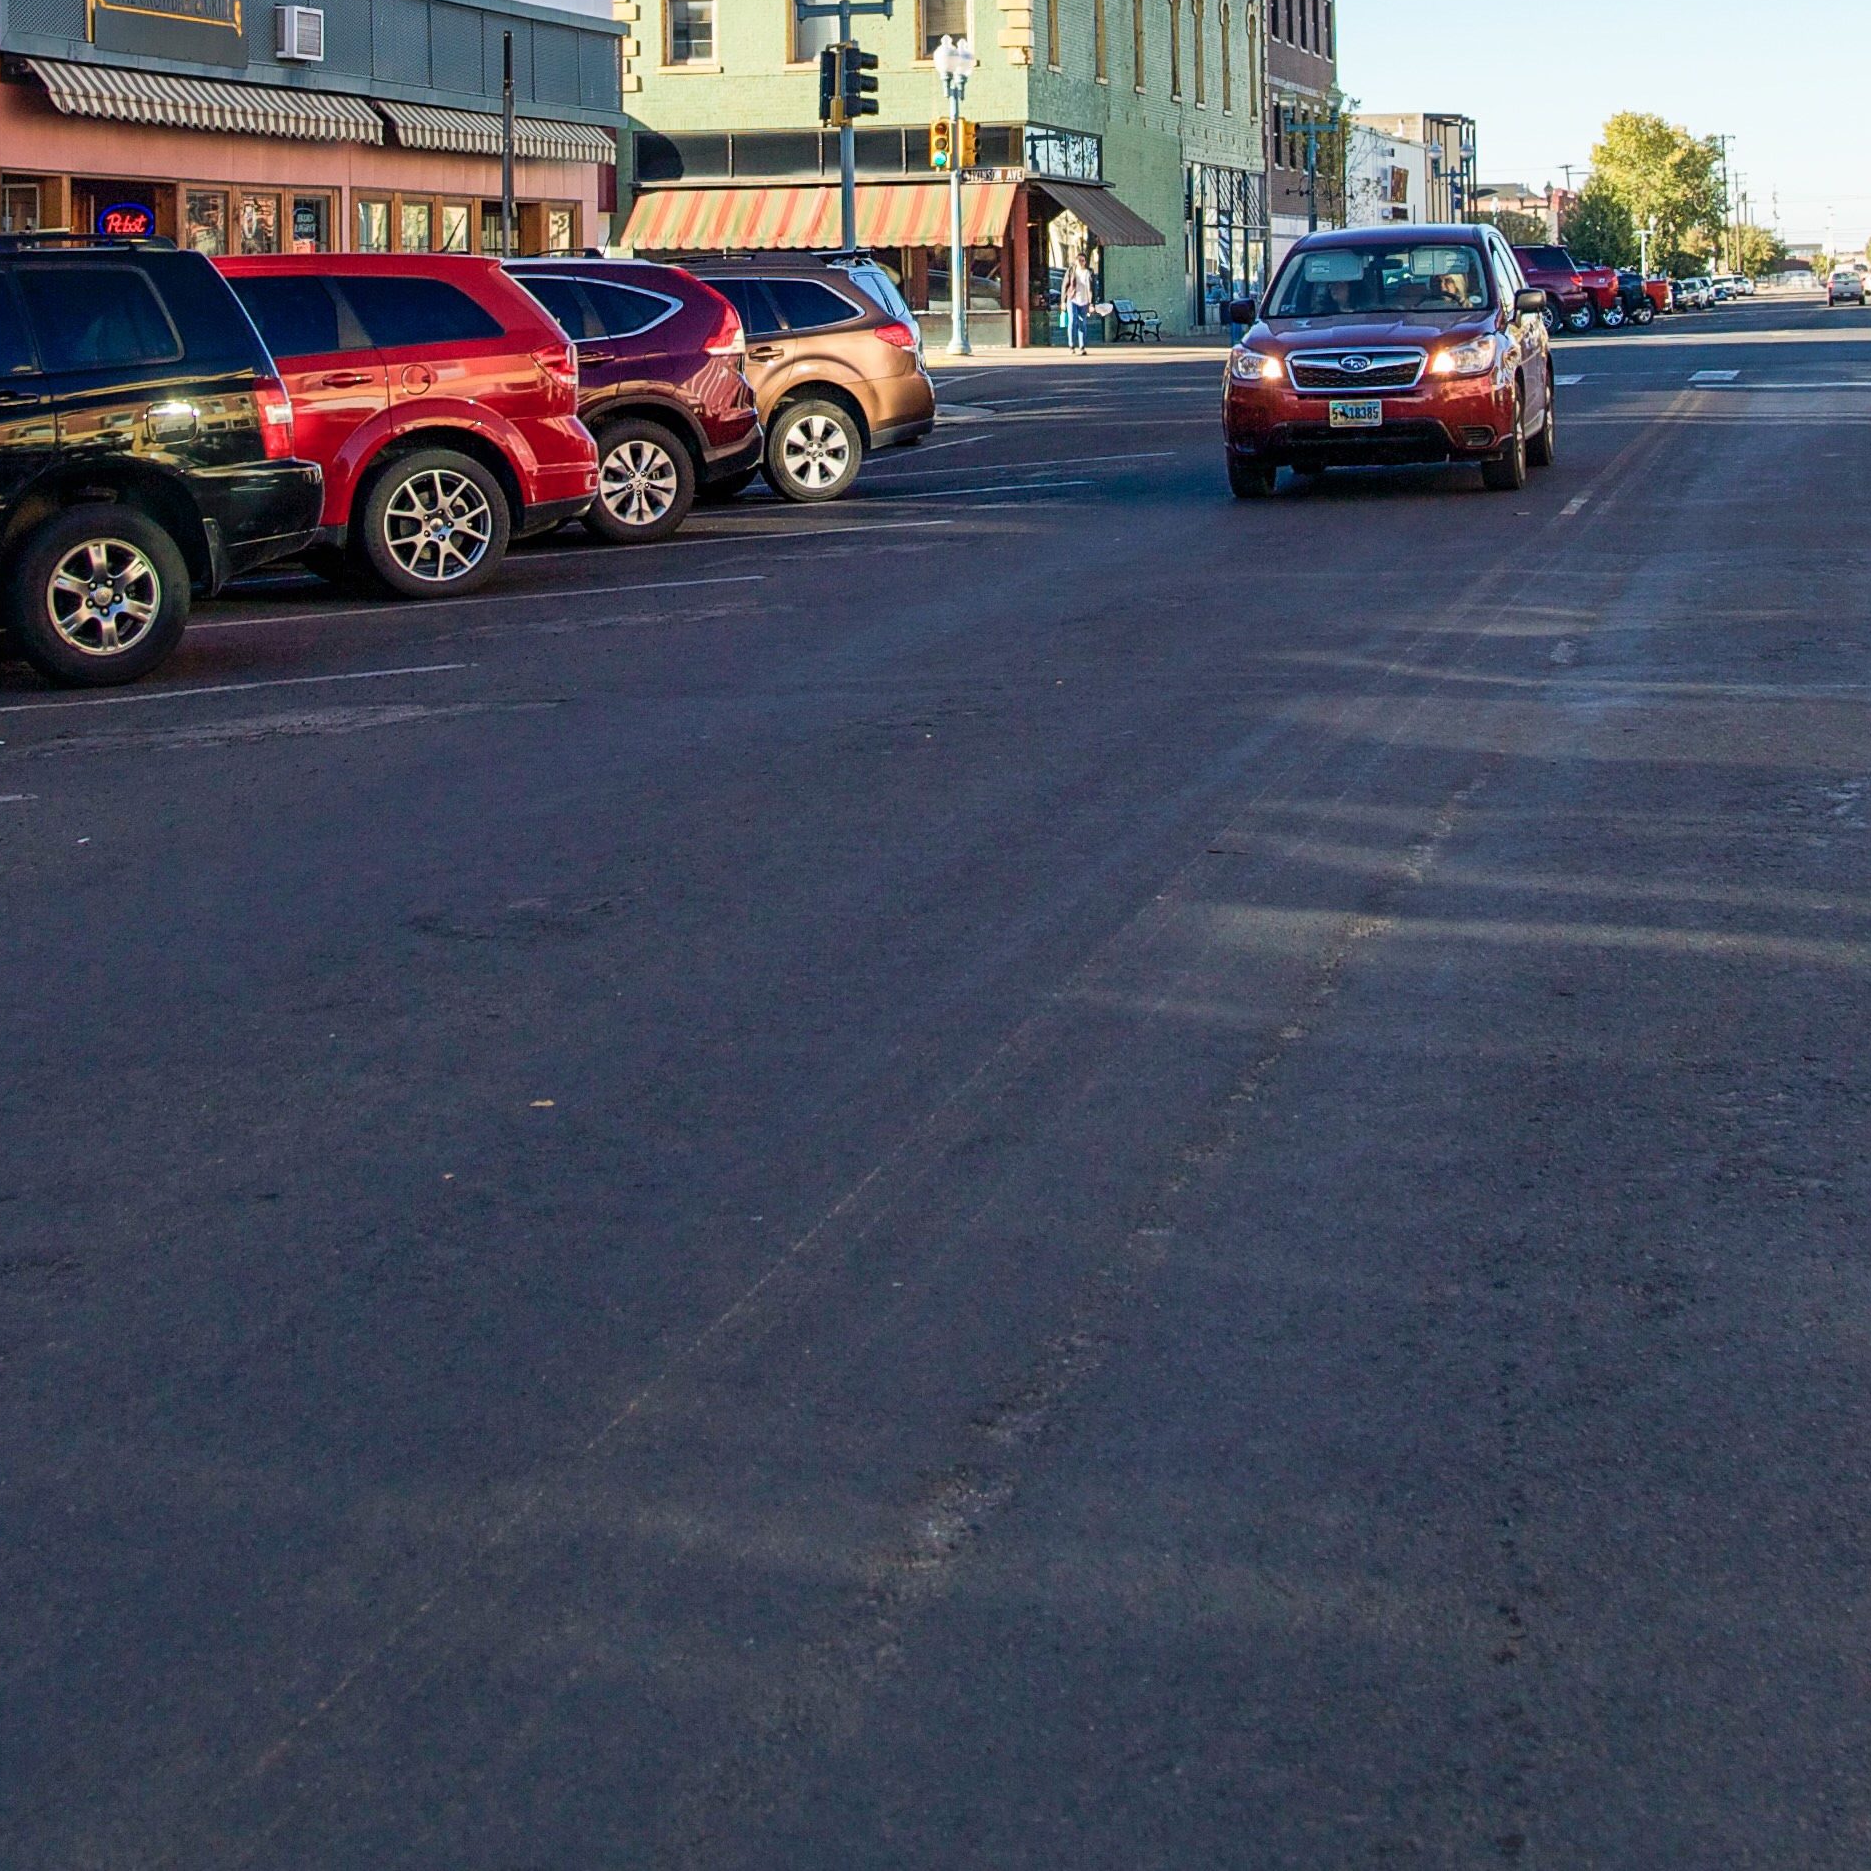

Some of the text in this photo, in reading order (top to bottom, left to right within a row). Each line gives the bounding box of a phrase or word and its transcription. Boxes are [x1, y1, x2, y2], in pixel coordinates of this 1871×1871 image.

[1006, 169, 1022, 181] AVE
[297, 214, 314, 223] BUD
[1349, 406, 1379, 419] 18385
